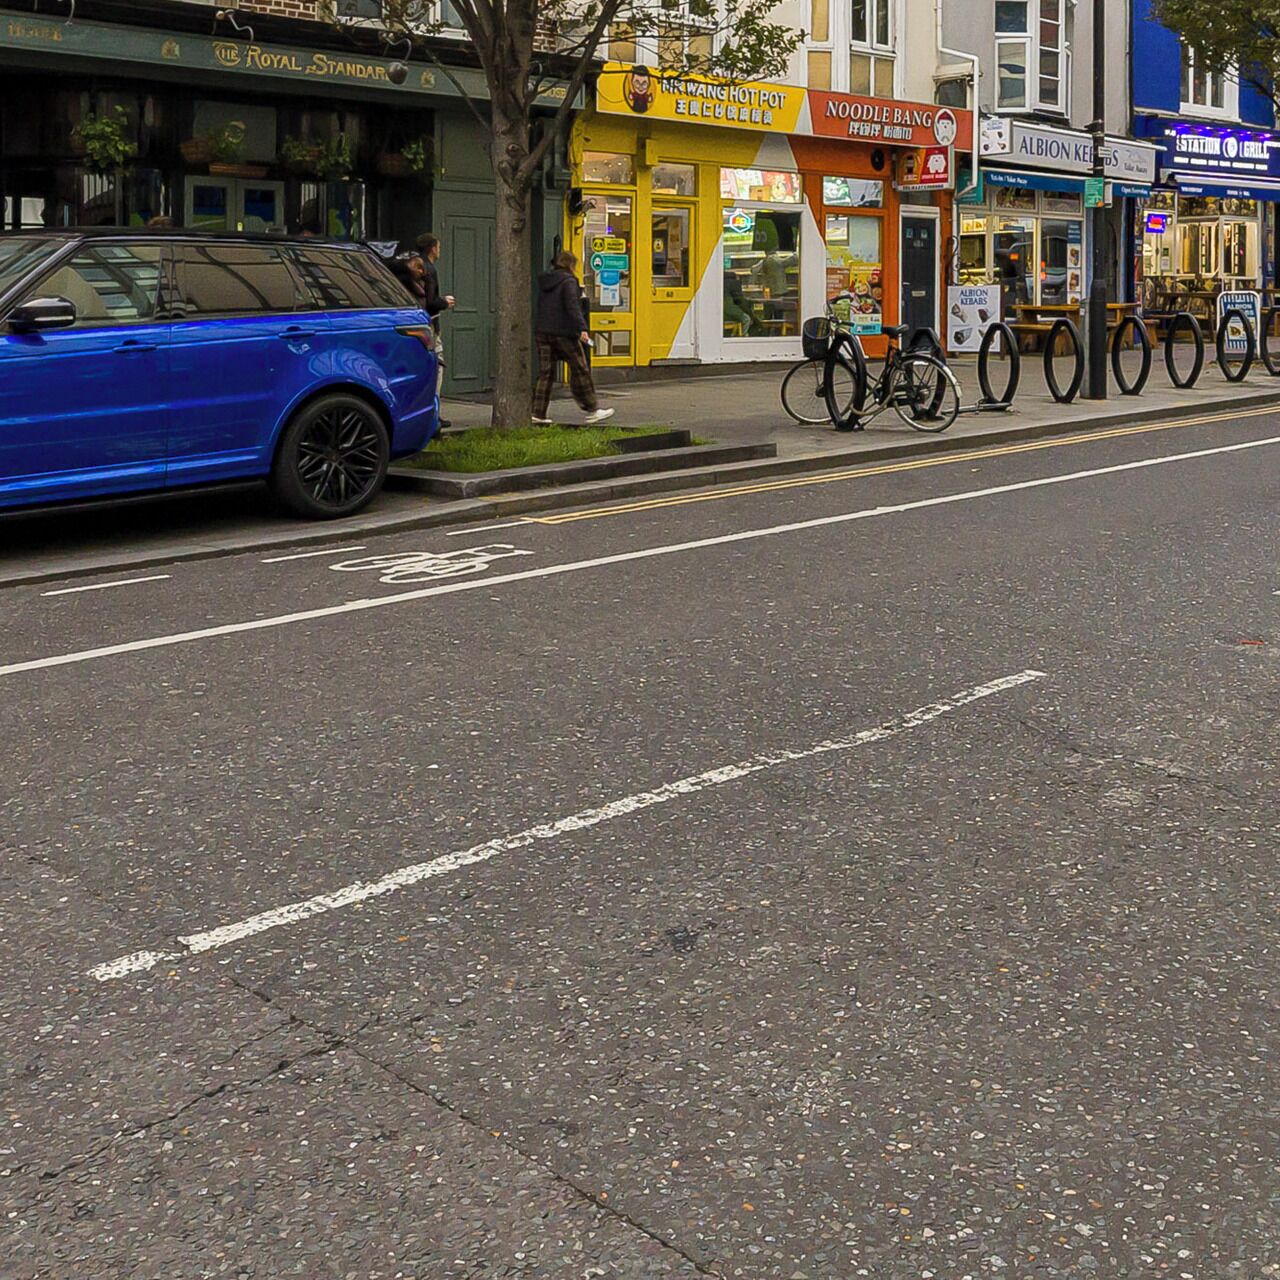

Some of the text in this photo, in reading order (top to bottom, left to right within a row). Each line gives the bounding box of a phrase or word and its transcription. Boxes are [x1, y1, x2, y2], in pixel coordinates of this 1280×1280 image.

[212, 41, 389, 81] THE ROYAL STANDAR
[686, 82, 727, 100] WANG
[729, 85, 757, 104] HOT
[759, 90, 786, 108] POT
[826, 100, 933, 128] NOODLE BANG
[1020, 135, 1119, 168] ALBION KEBBS
[1177, 135, 1269, 159] STATION GRILL
[960, 289, 988, 297] ALBION
